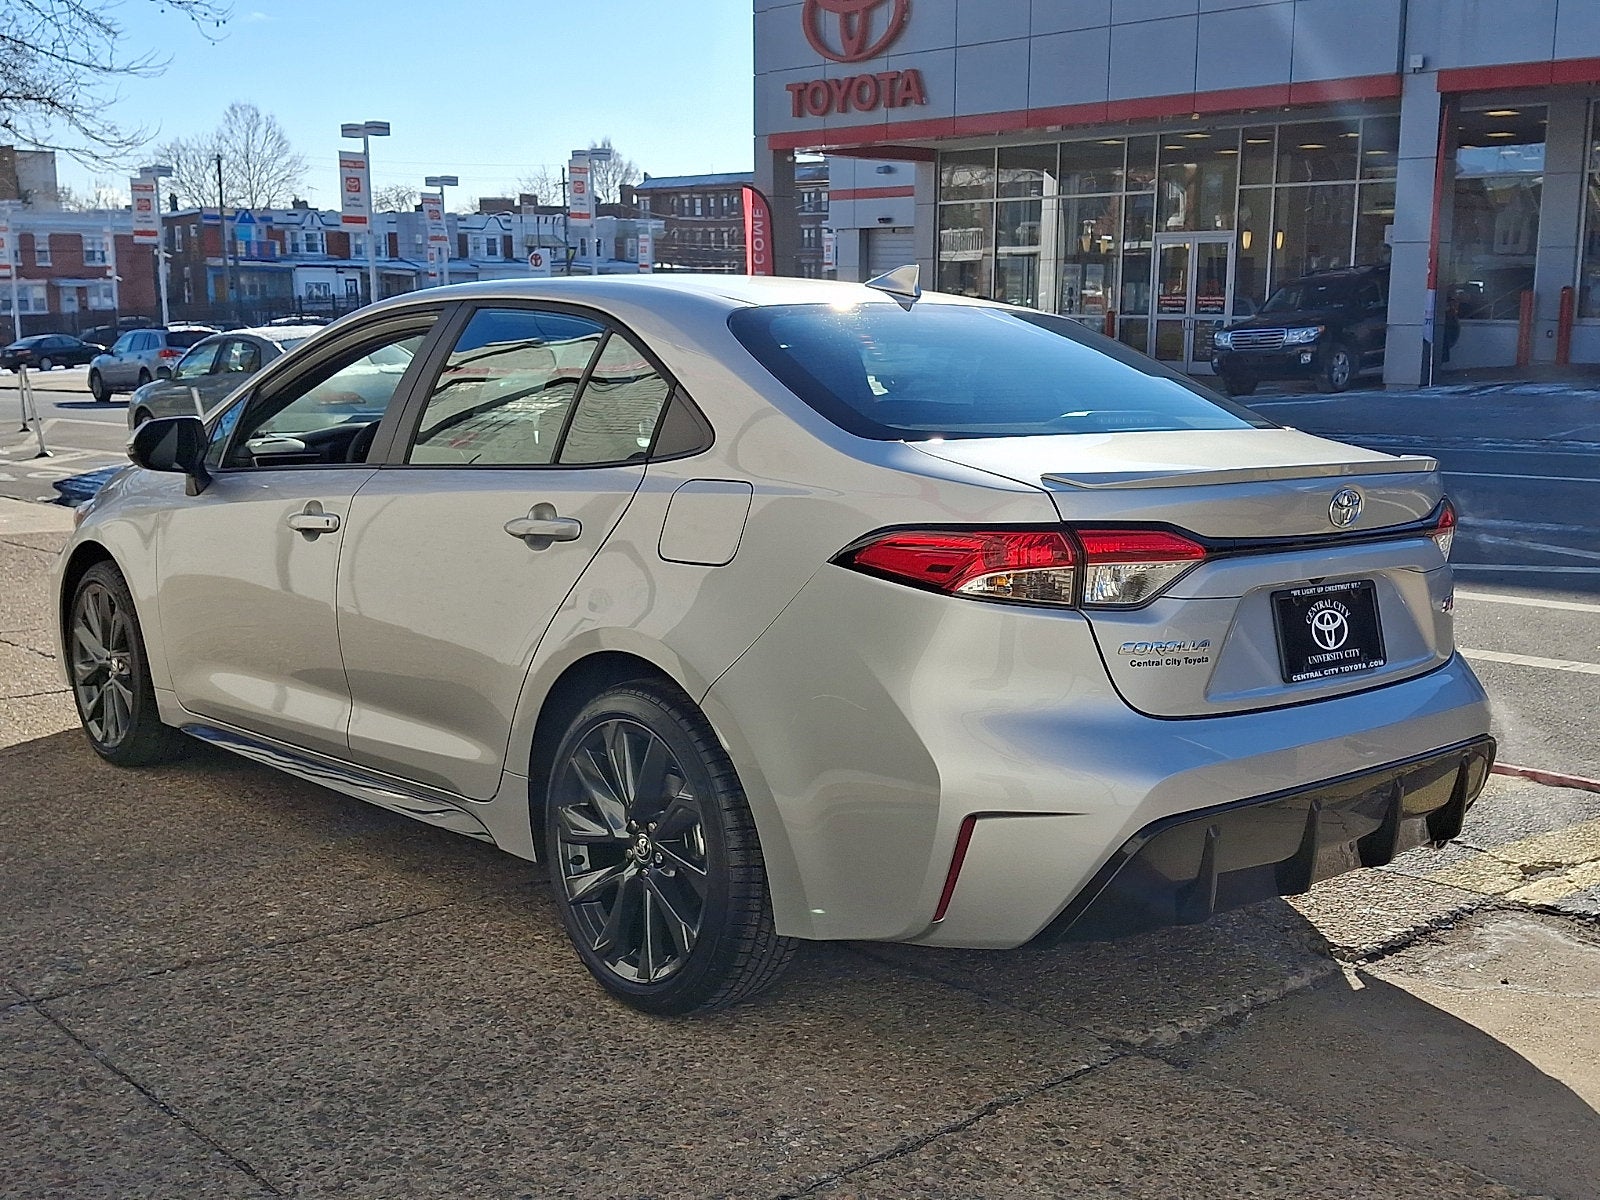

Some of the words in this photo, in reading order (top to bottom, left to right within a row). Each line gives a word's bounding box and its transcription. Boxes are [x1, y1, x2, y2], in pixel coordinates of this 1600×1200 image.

[785, 69, 926, 118] TOYOTA
[1301, 587, 1316, 595] LIGHT
[1316, 586, 1324, 594] UP
[1324, 583, 1351, 592] CHESTNUT
[1305, 599, 1333, 624] CENTRAL
[1333, 600, 1351, 618] CITY
[1117, 638, 1211, 656] COROLLA
[1129, 658, 1163, 668] Central
[1165, 657, 1182, 667] City
[1183, 656, 1209, 666] Toyota
[1308, 650, 1344, 665] UNIVERSITY
[1344, 648, 1361, 658] CITY
[1292, 671, 1322, 682] CENTRAL
[1323, 667, 1339, 676] CITY
[1340, 663, 1366, 673] TOYOTA
[1367, 659, 1384, 669] .COM
